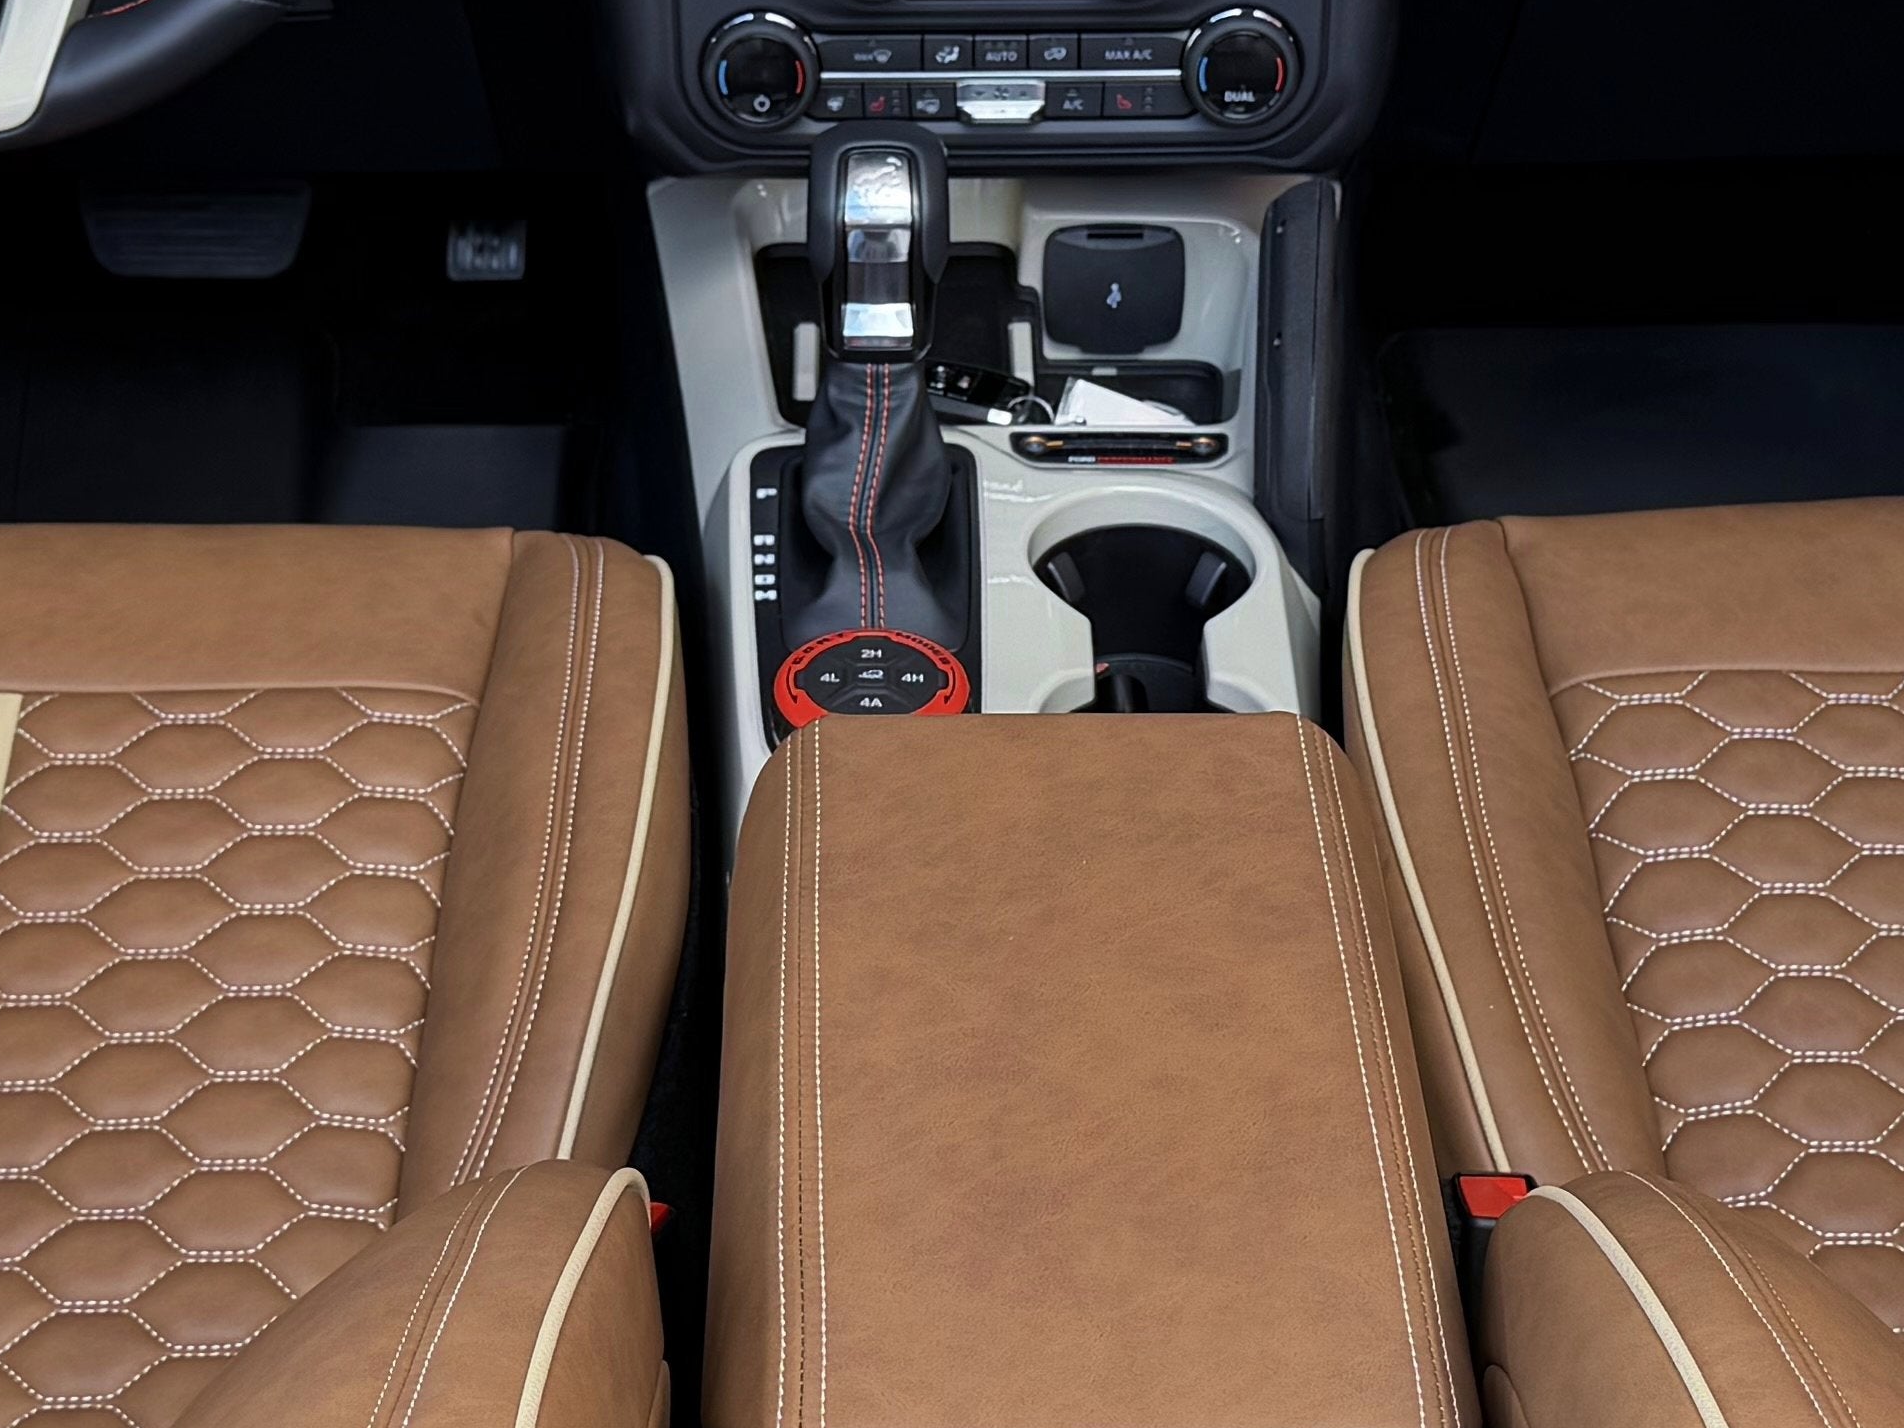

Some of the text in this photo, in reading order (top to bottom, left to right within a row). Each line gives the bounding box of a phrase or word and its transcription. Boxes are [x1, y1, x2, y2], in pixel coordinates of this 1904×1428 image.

[985, 49, 1018, 63] AUTO
[1223, 89, 1256, 104] DUAL
[1062, 97, 1085, 111] A/C
[859, 648, 883, 659] 2H
[819, 672, 841, 684] 4L
[900, 672, 925, 684] 4H
[858, 696, 884, 708] 4A
